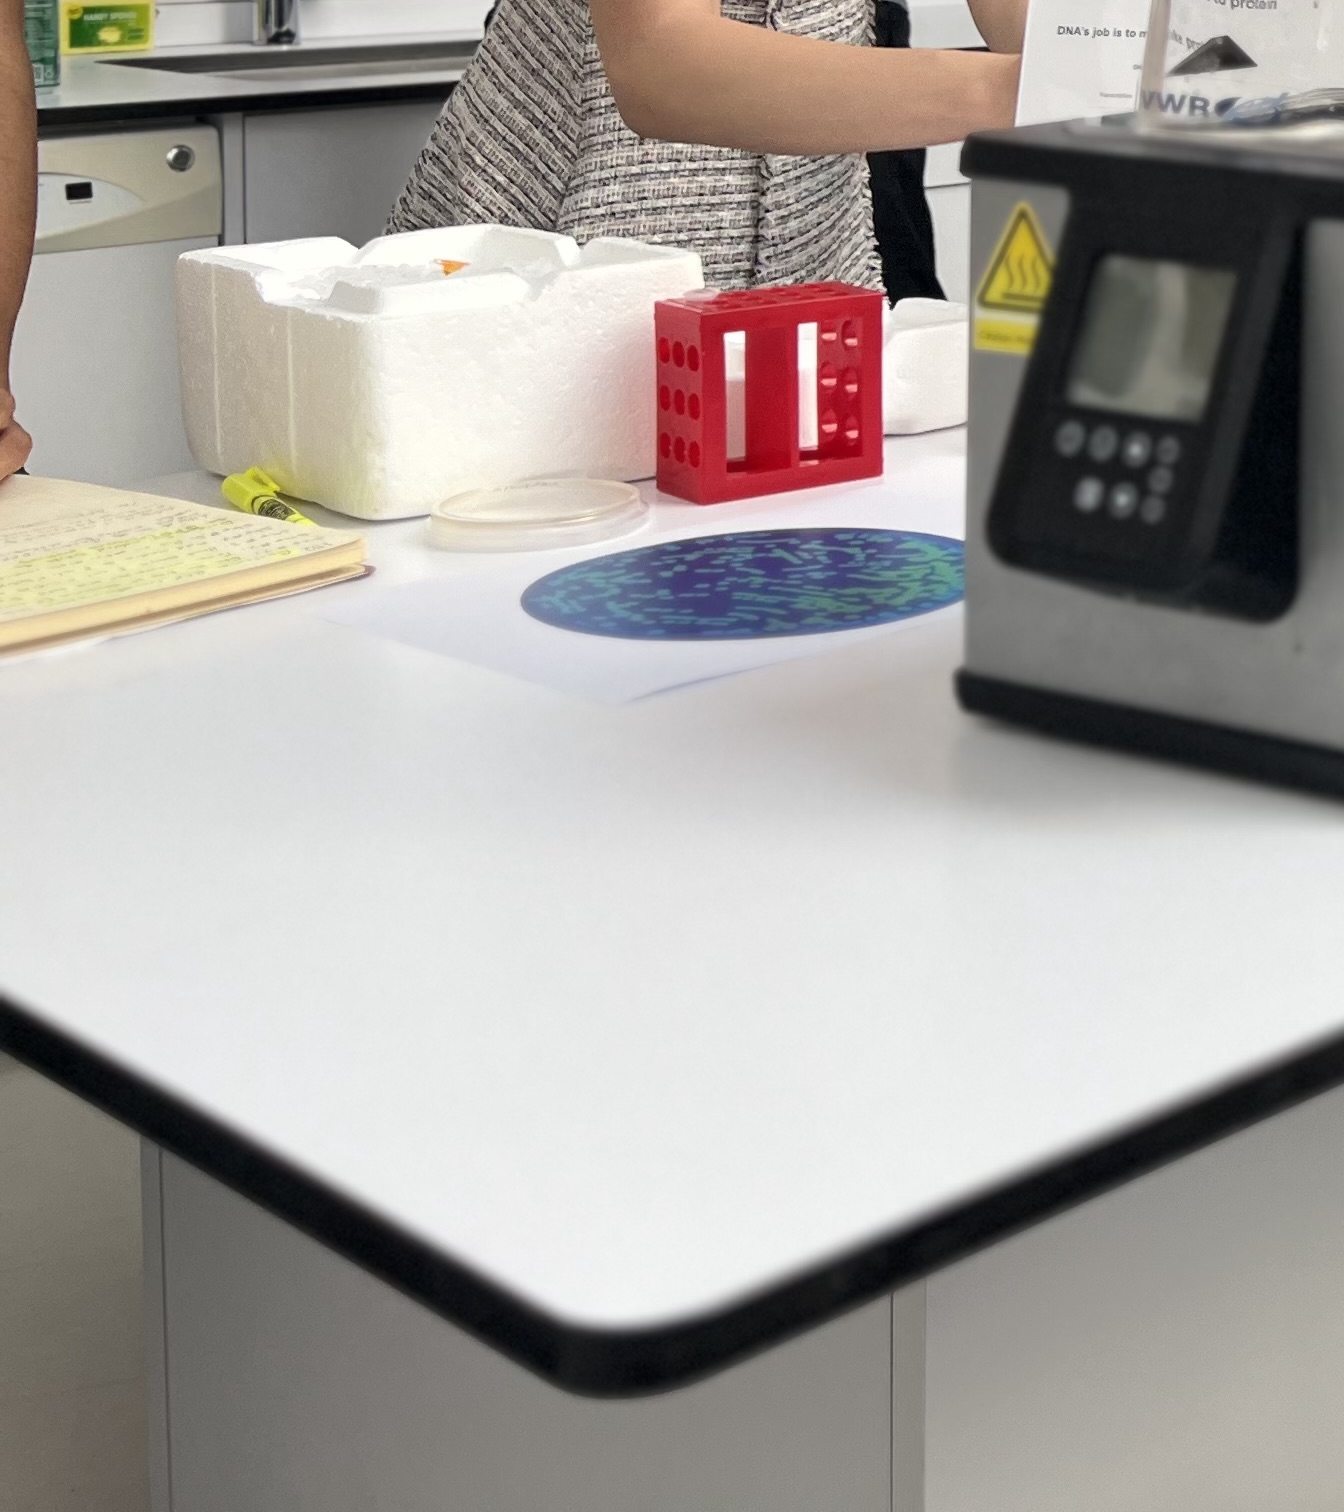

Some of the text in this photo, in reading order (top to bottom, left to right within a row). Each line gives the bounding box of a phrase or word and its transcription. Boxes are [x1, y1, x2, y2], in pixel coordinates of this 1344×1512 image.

[1057, 25, 1090, 37] DNA's
[1091, 28, 1110, 39] job
[1113, 28, 1122, 38] is
[1125, 29, 1136, 39] to
[1141, 90, 1211, 118] VWR
